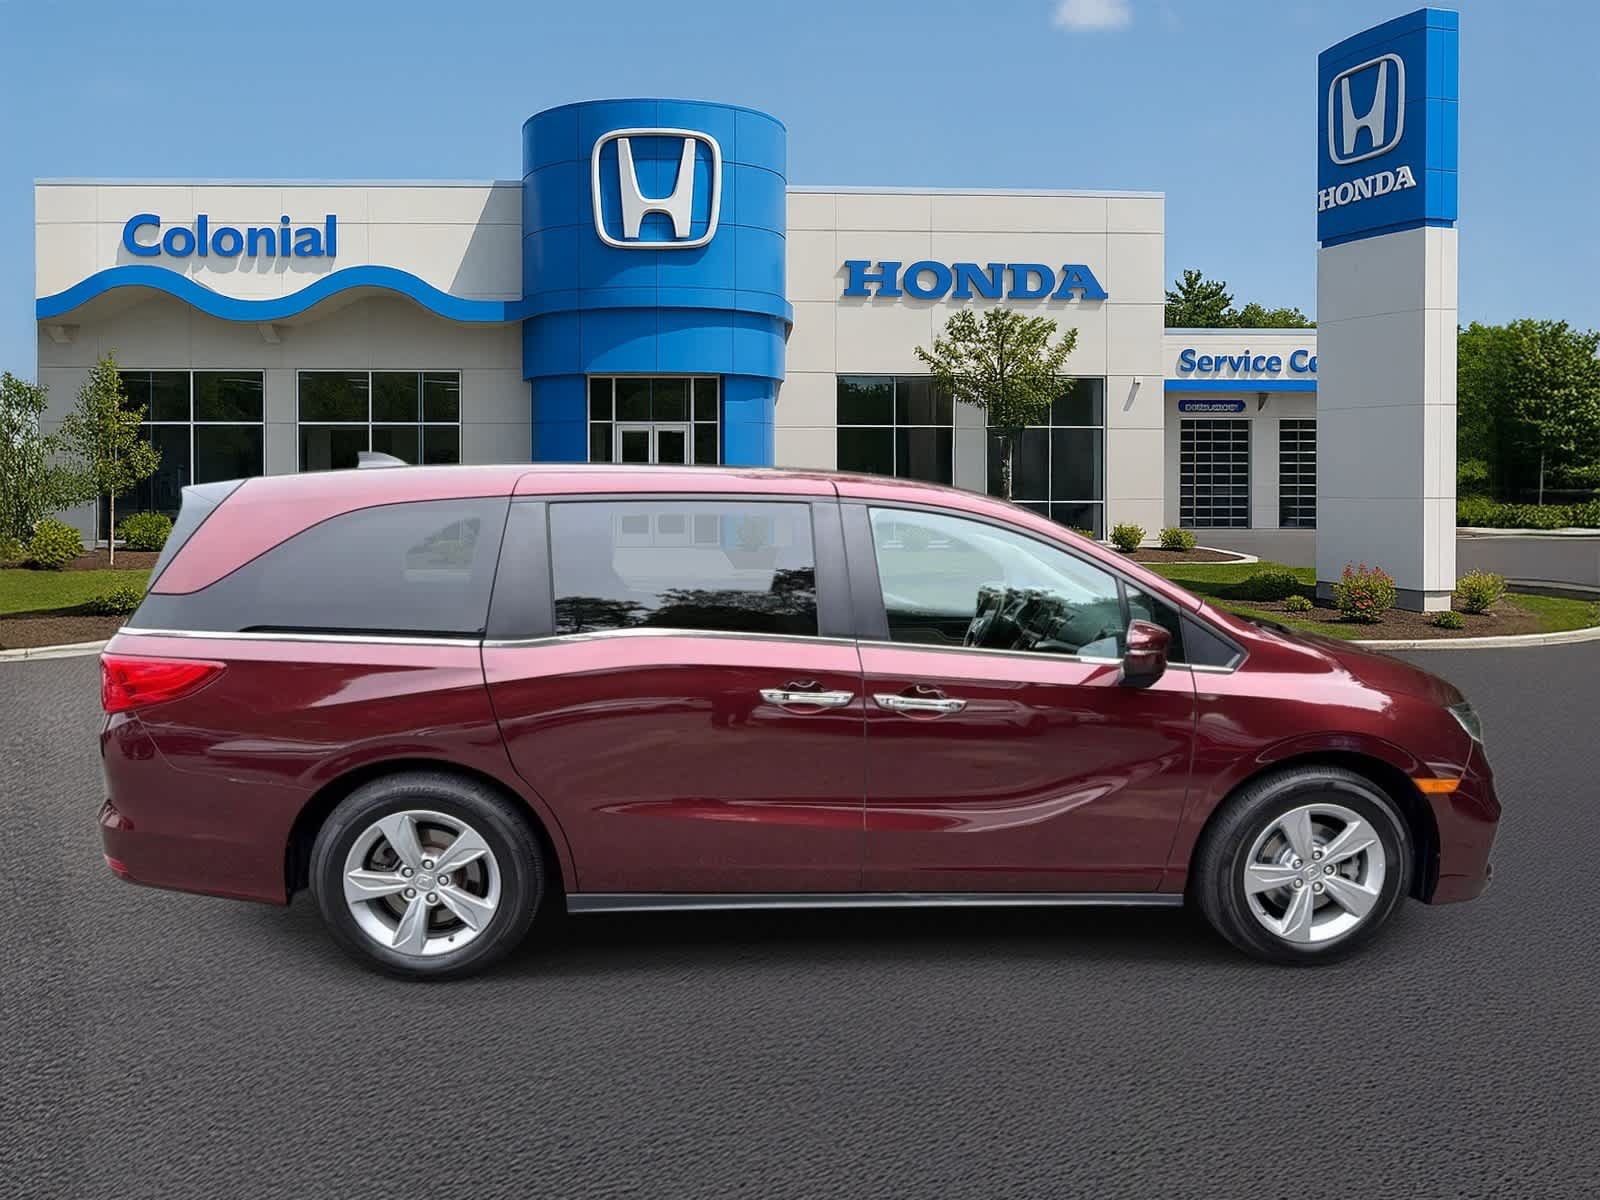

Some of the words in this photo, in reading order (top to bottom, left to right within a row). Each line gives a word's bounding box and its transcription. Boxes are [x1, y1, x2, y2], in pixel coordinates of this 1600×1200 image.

[1318, 165, 1417, 212] HONDA
[122, 213, 337, 257] Colonial
[843, 259, 1109, 300] HONDA
[1180, 348, 1282, 373] Service
